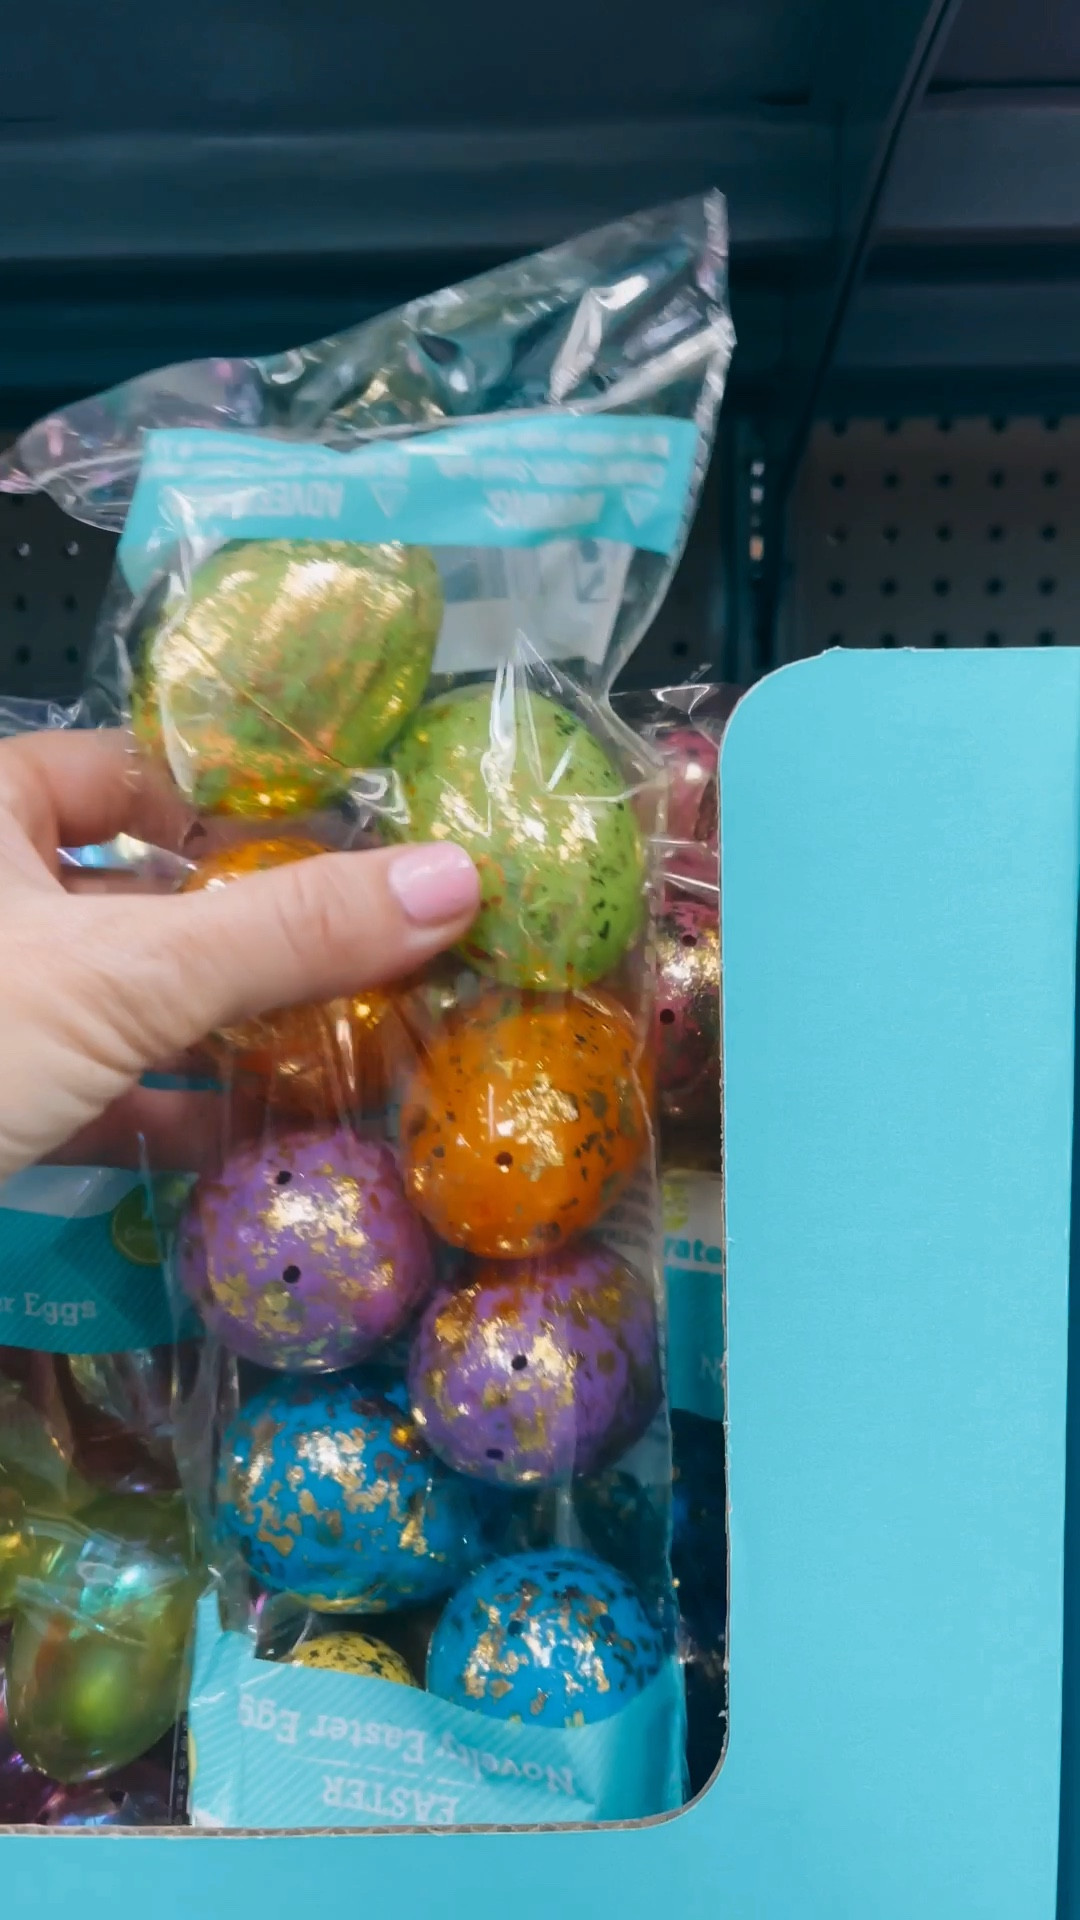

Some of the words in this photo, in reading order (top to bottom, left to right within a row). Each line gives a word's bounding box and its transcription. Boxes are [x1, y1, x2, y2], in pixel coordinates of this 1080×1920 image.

[24, 1292, 96, 1326] Eggs
[309, 1713, 428, 1765] Easter
[322, 1774, 460, 1824] EASTER
